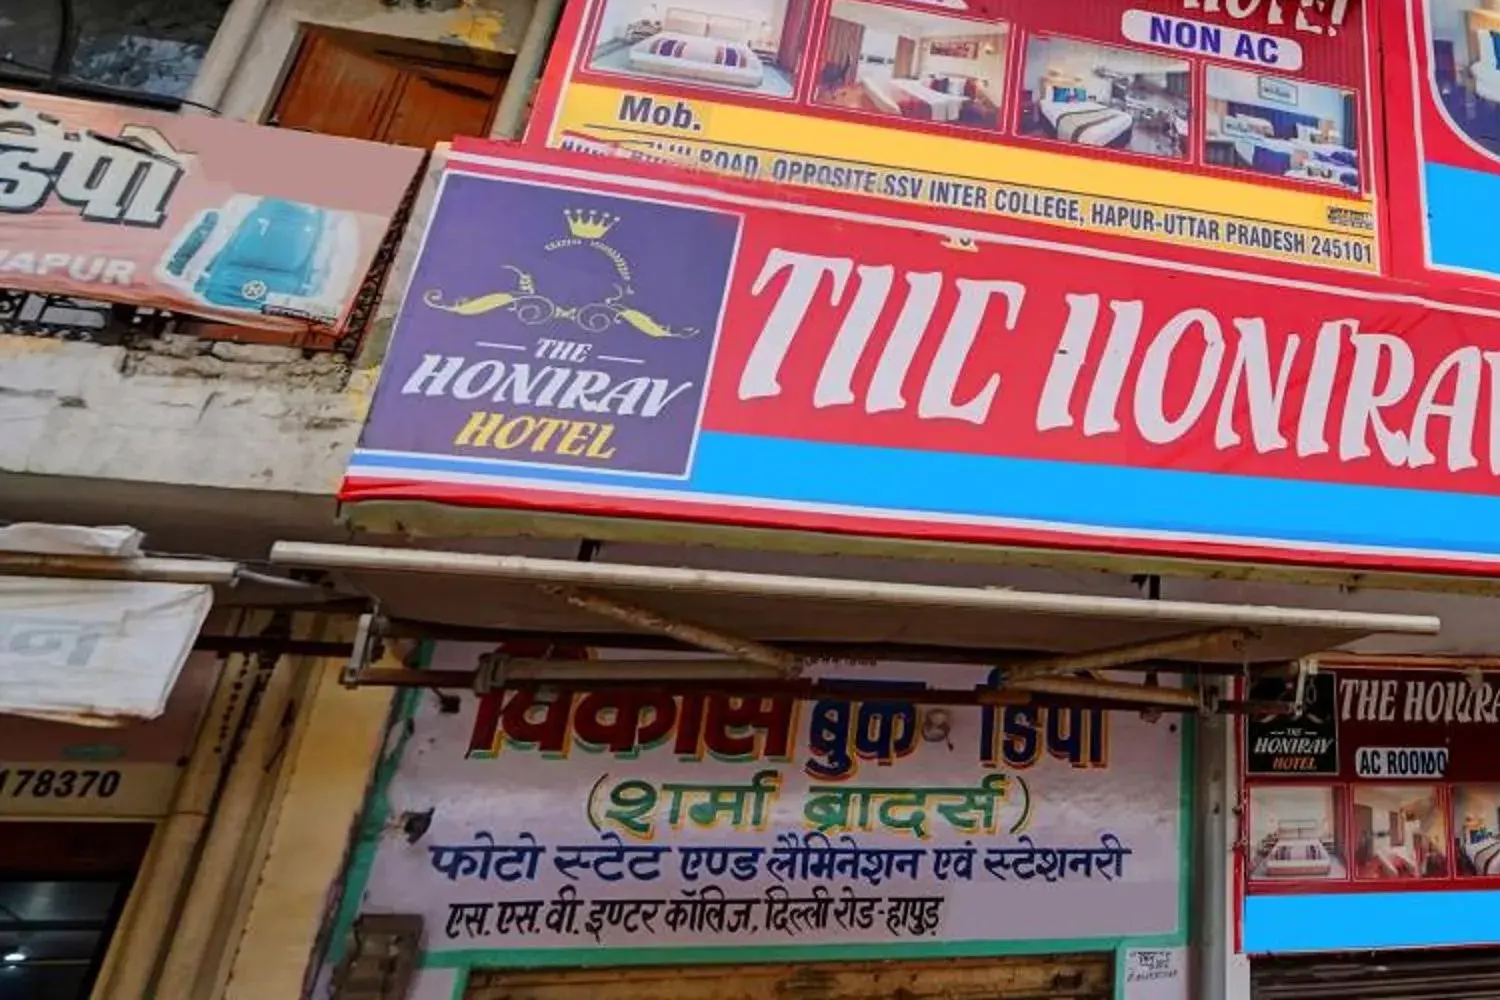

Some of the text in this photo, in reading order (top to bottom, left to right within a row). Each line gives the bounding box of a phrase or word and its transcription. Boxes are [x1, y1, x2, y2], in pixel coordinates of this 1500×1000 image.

[1150, 16, 1279, 64] NON AC
[619, 94, 702, 131] Mob.
[885, 174, 924, 199] SSV
[928, 182, 986, 208] INTER
[995, 189, 1084, 227] COLLEGE,
[1091, 204, 1220, 242] HAPUR-UTTAR
[1226, 224, 1305, 254] PRADESH
[1311, 236, 1372, 265] 245101
[535, 338, 592, 363] THE
[402, 353, 693, 417] HONIRAV
[454, 411, 616, 459] HOTEL
[1340, 679, 1398, 721] THE
[1254, 737, 1334, 754] HONIRAV
[1360, 750, 1381, 775] AC
[429, 830, 1132, 885] फोटो स्टेट एण्ड लैमिनेशन एवं स्टेशनरी
